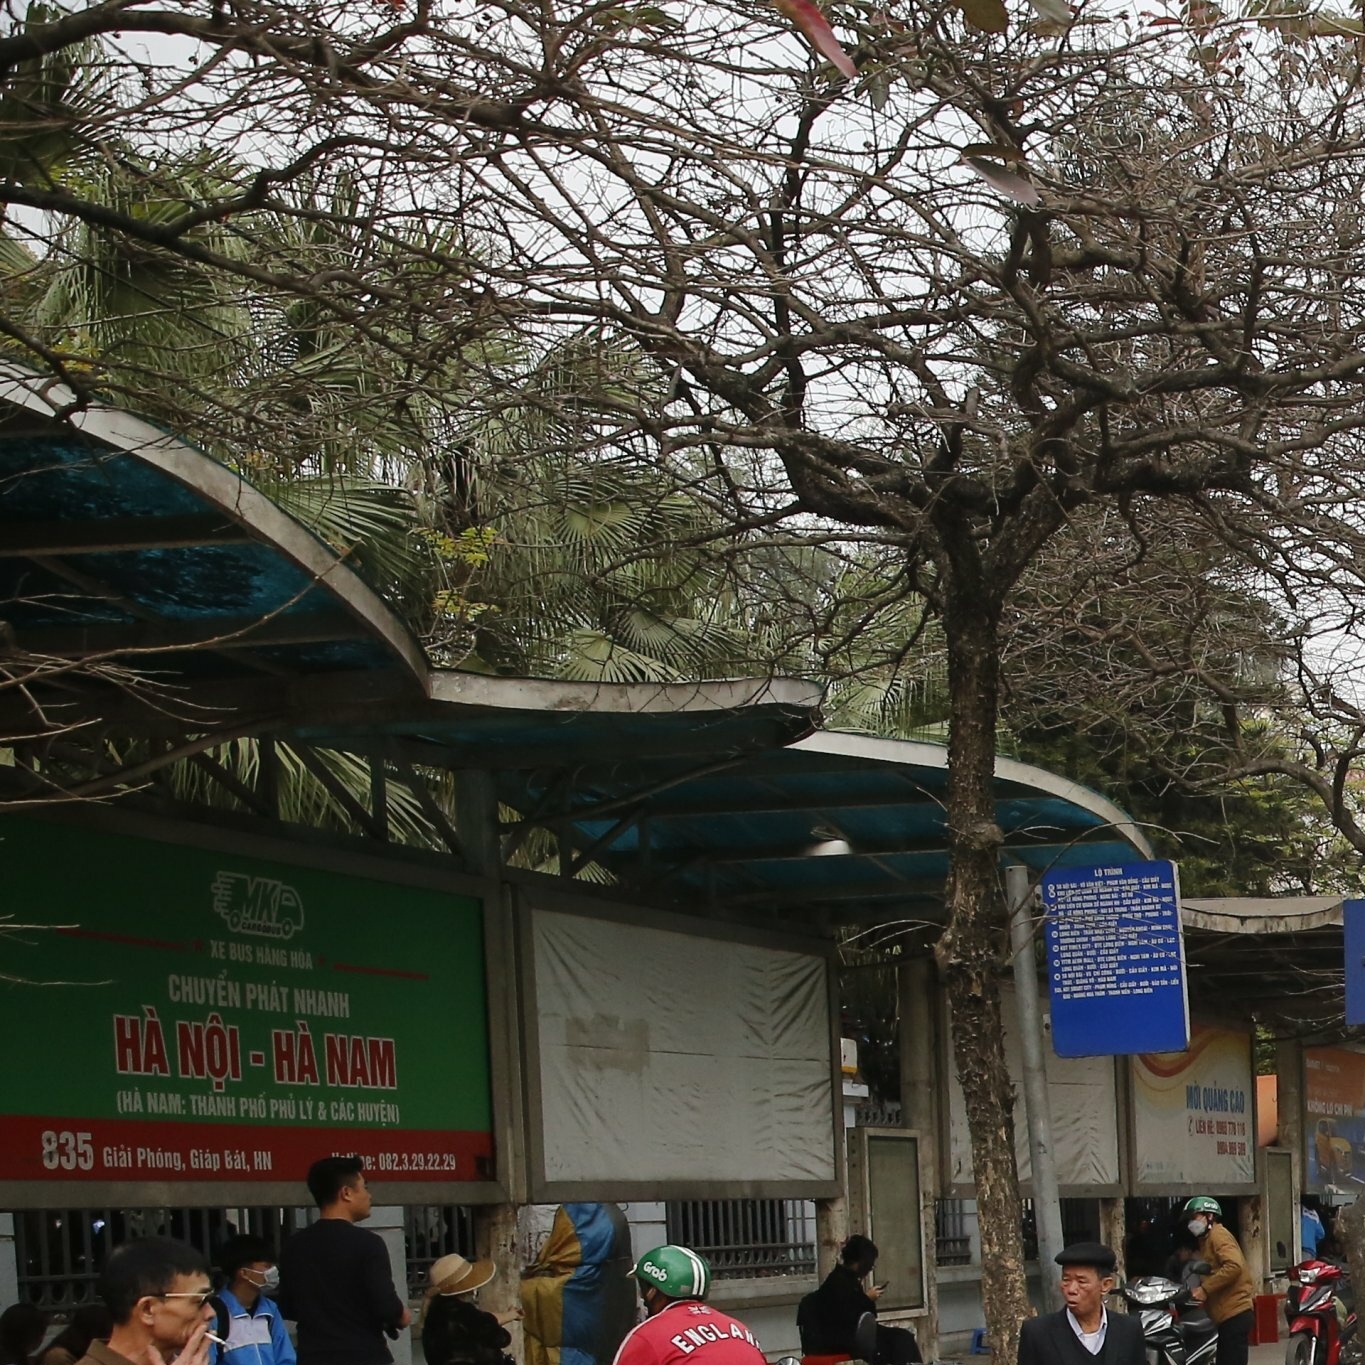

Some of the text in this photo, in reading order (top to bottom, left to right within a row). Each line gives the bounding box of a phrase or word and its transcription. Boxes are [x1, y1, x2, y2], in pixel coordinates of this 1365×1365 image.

[210, 940, 226, 960] XE
[229, 943, 253, 963] BUS
[256, 944, 288, 967] HÀNG
[168, 969, 350, 1018] CHUYỂN PHÁT NHANH
[113, 1004, 397, 1092] HÀ NỘI - HÀ NAM
[117, 1087, 400, 1126] (HÀ NAM: THÀNH PHỐ PHỦ LÝ & CÁC HUYỆN)
[42, 1131, 94, 1170] 835
[103, 1144, 132, 1169] Giải
[137, 1147, 186, 1171] Phóng,
[190, 1148, 221, 1172] Giáp
[253, 1151, 272, 1171] HN
[379, 1153, 456, 1171] 082.3.29.22.29
[643, 1261, 668, 1282] Grab
